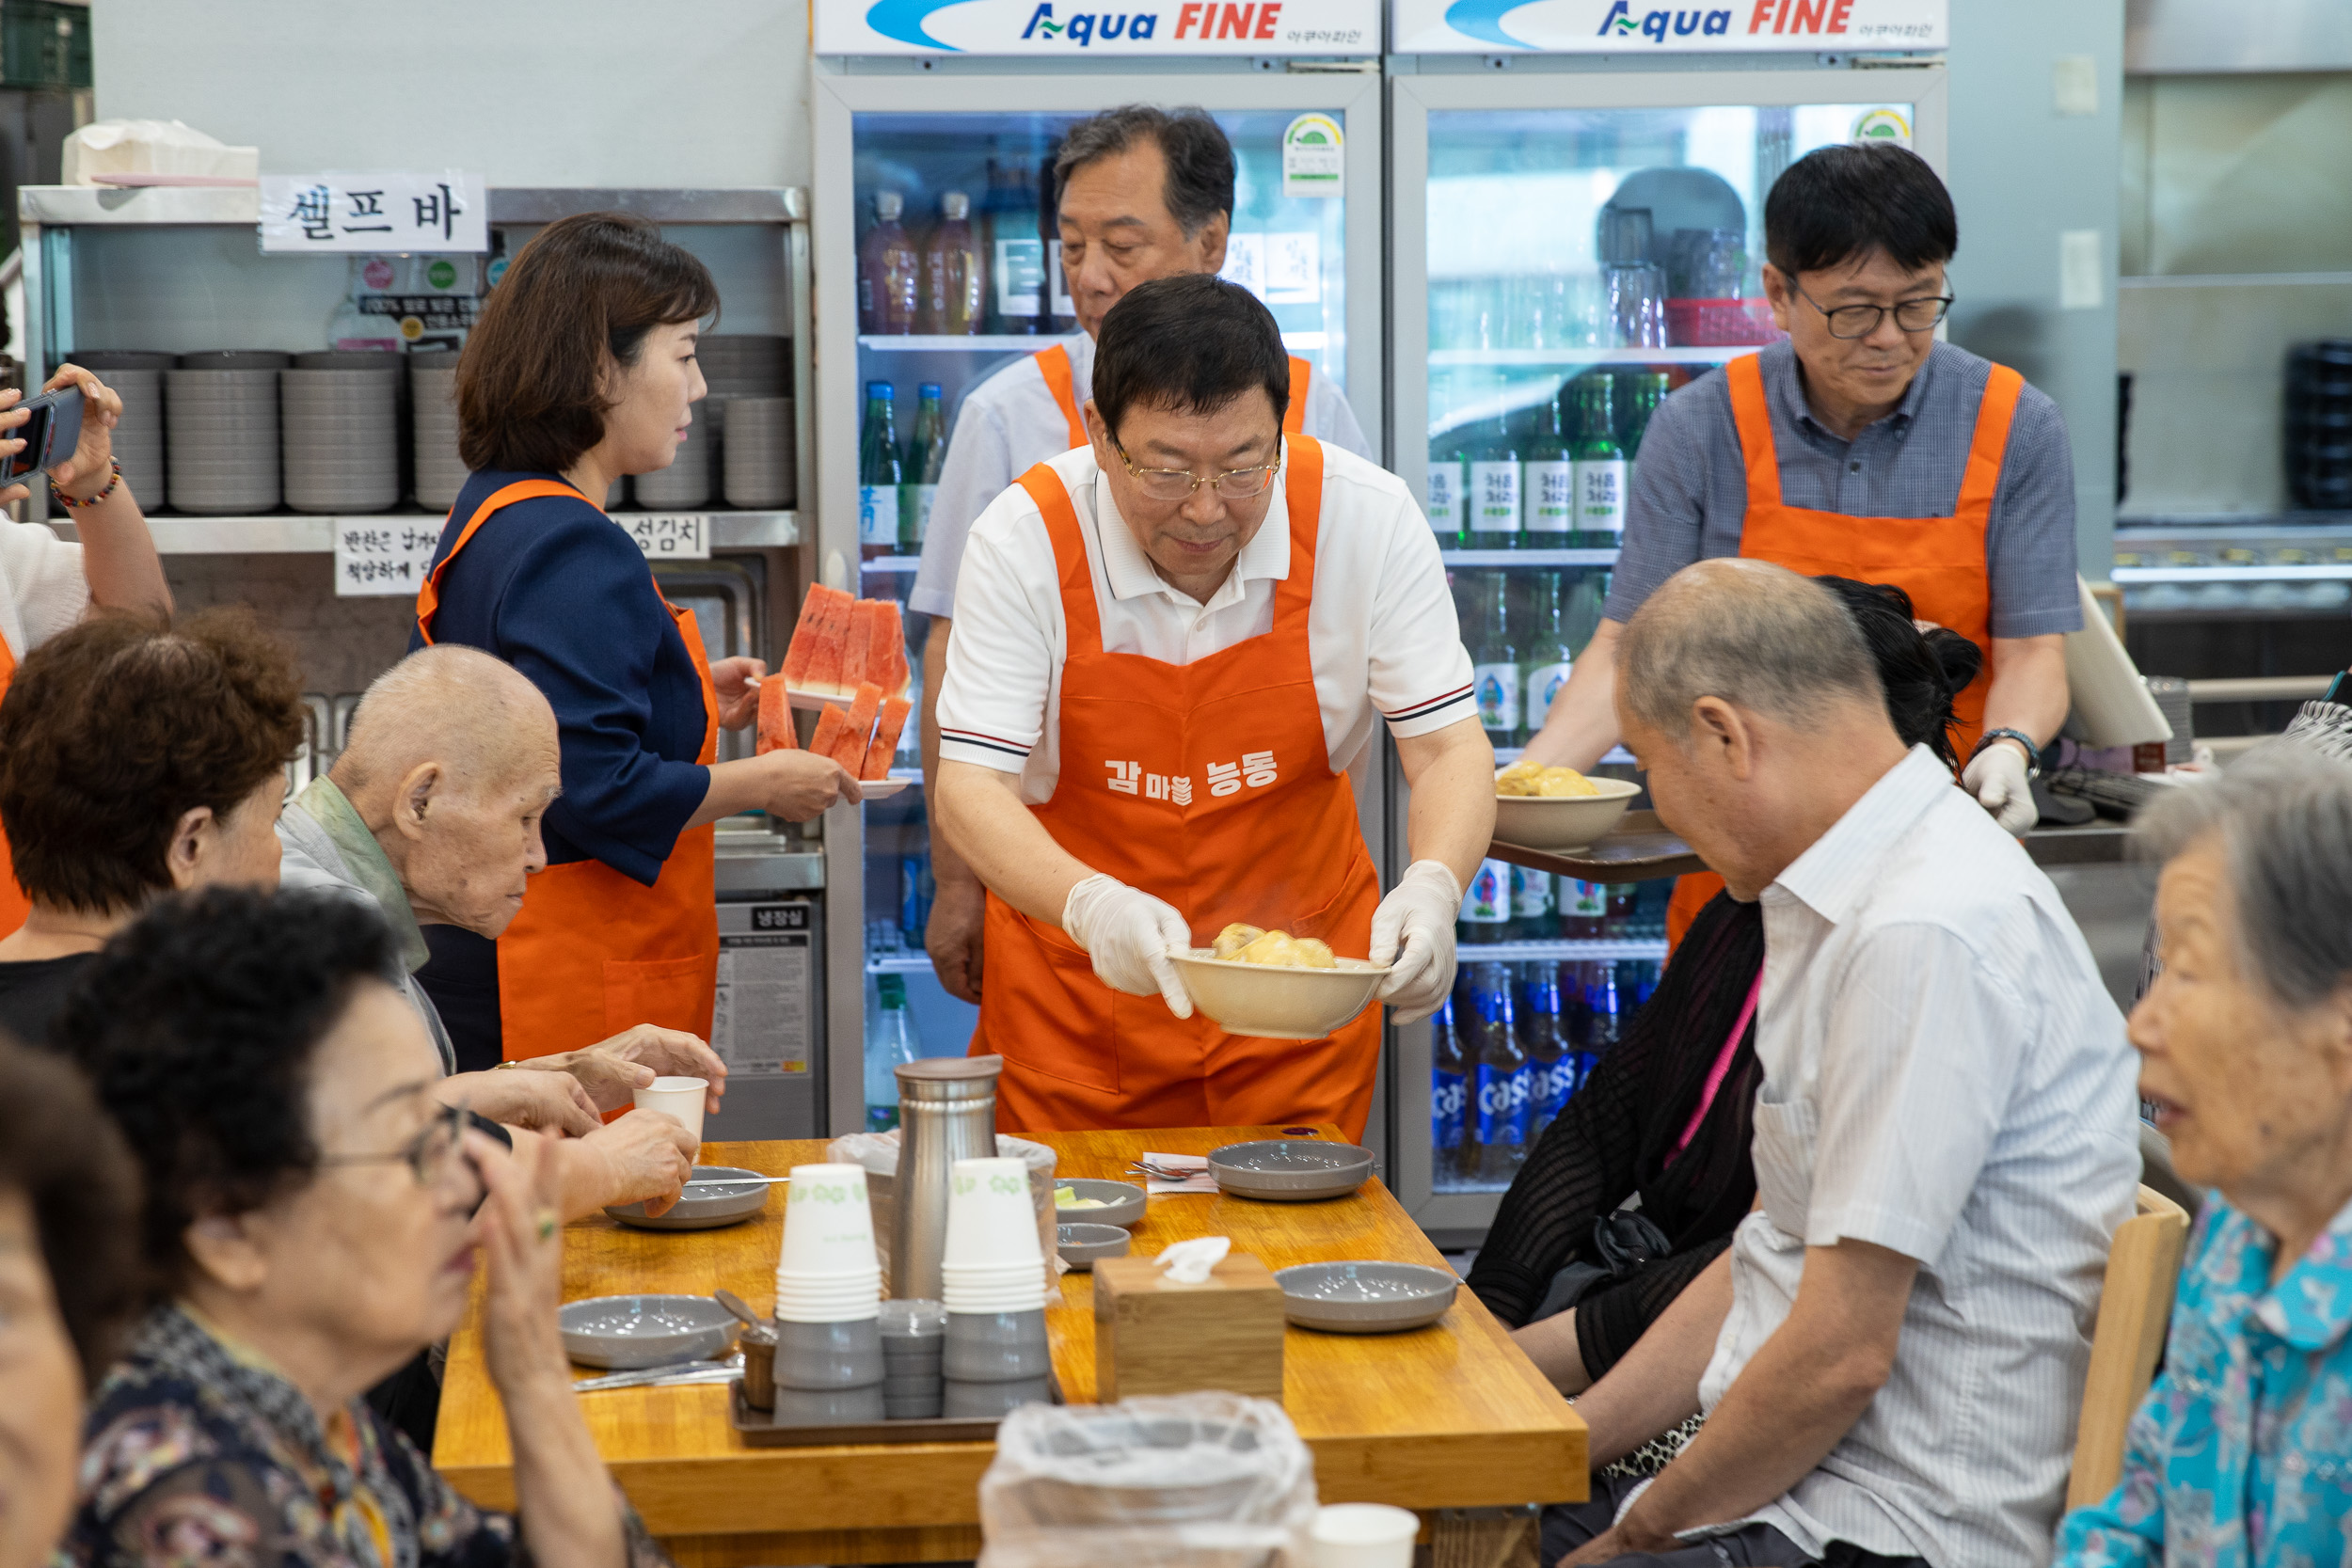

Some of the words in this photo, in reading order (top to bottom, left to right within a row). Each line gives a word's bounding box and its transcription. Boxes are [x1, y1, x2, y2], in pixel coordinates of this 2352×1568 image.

[1020, 3, 1157, 47] Aqua
[1174, 3, 1283, 40] FINE
[1597, 0, 1732, 43] Aqua
[1747, 0, 1855, 35] FINE
[412, 182, 461, 241] 바
[615, 516, 700, 553] 성김치
[1206, 750, 1278, 797] 능동
